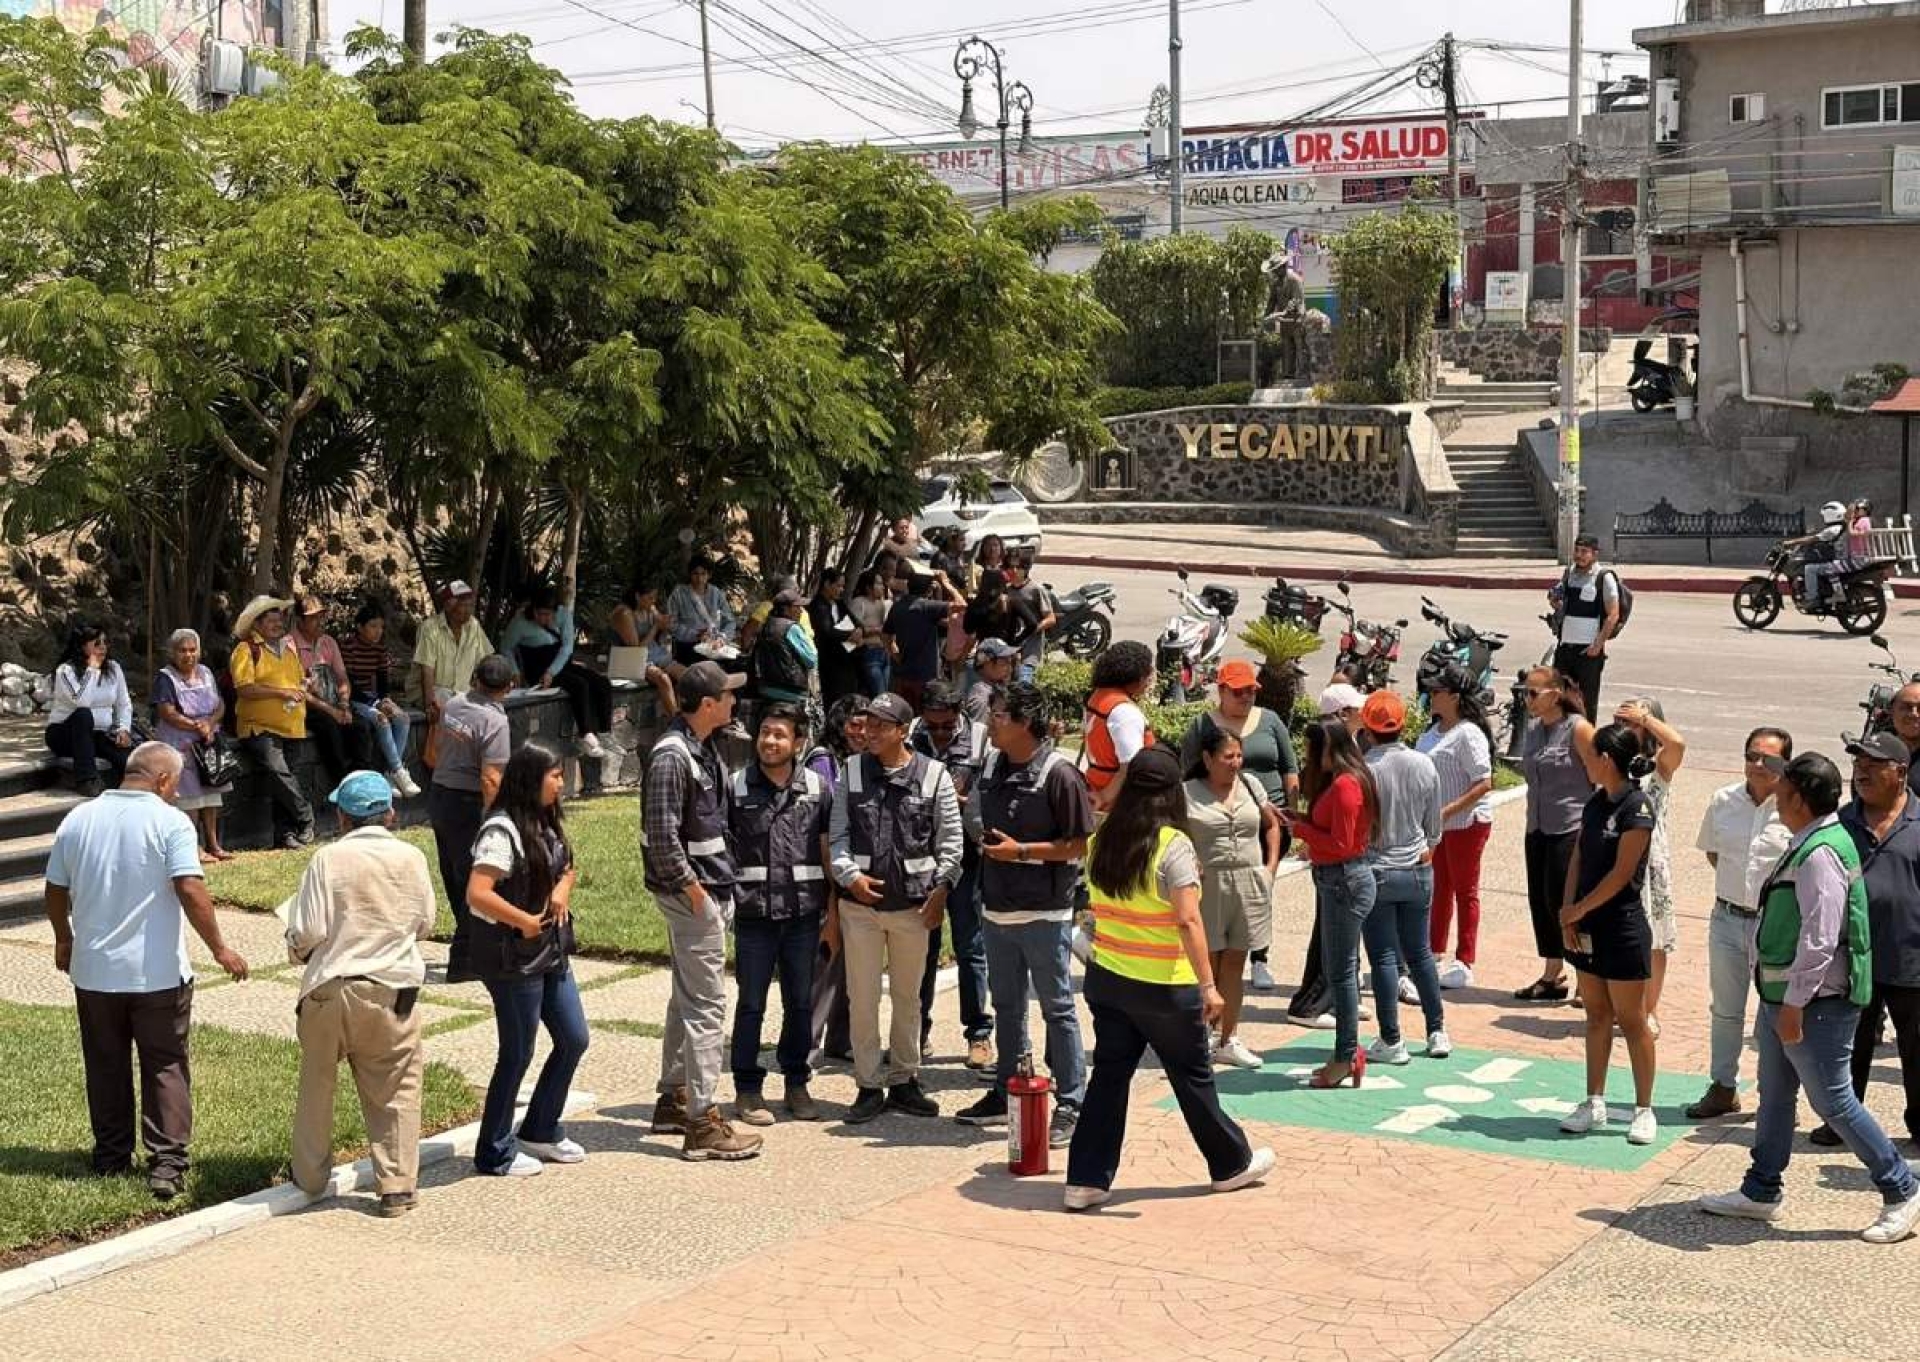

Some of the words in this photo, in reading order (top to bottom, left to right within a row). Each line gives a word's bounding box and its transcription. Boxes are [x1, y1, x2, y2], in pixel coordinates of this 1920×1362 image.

[909, 148, 993, 169] TERNET
[1147, 134, 1292, 173] RMACIA
[1189, 187, 1230, 206] AQUA
[1233, 184, 1289, 205] CLEAN
[1174, 423, 1399, 463] YECAPIXTL
